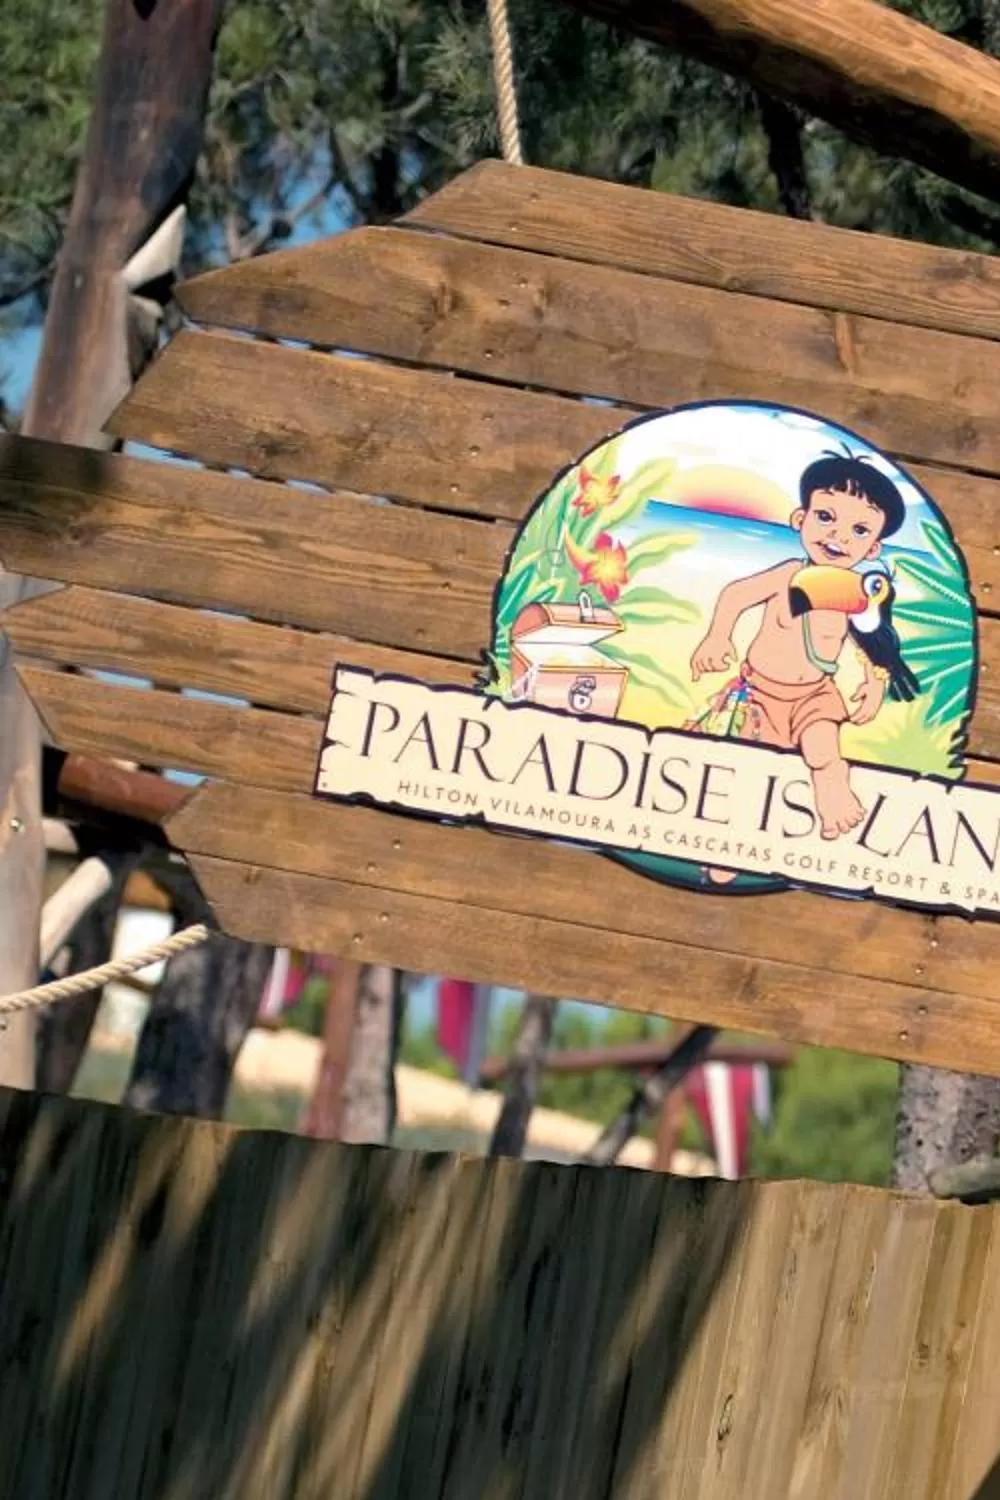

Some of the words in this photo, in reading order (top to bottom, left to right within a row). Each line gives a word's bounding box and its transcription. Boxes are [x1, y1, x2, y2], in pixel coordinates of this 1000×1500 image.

[359, 700, 735, 826] PARADISE
[398, 780, 478, 806] HILTON
[491, 797, 615, 832] VILAMOURA
[628, 824, 651, 840] AS
[664, 830, 772, 861] CASCATAS
[784, 852, 837, 874] GOLF
[848, 865, 926, 892] RESORT
[939, 881, 951, 895] &
[965, 885, 1000, 904] SPA
